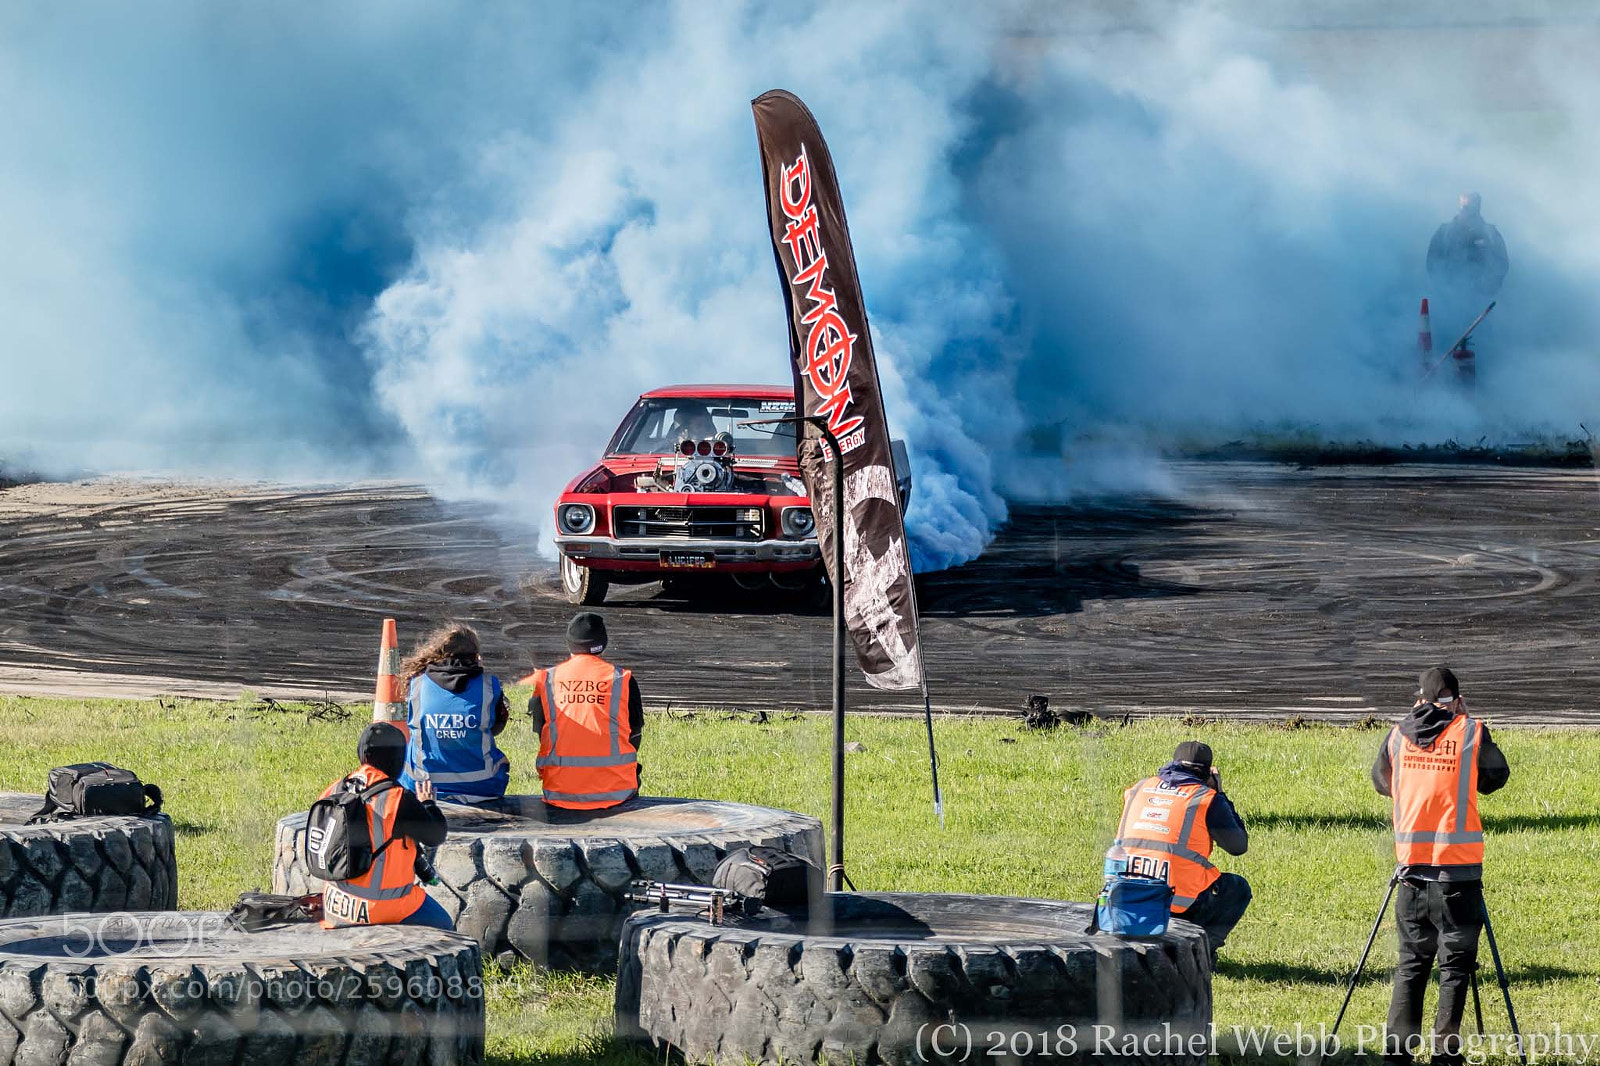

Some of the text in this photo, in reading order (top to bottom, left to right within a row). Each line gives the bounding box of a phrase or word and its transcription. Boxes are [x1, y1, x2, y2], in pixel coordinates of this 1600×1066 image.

[780, 142, 864, 448] DEMON
[823, 428, 866, 461] EERGY
[560, 681, 608, 693] NZBC
[559, 694, 606, 705] JUDGE
[425, 713, 477, 729] NZBC
[435, 729, 467, 739] CREW
[1403, 763, 1456, 773] PHOTOGRAPHY
